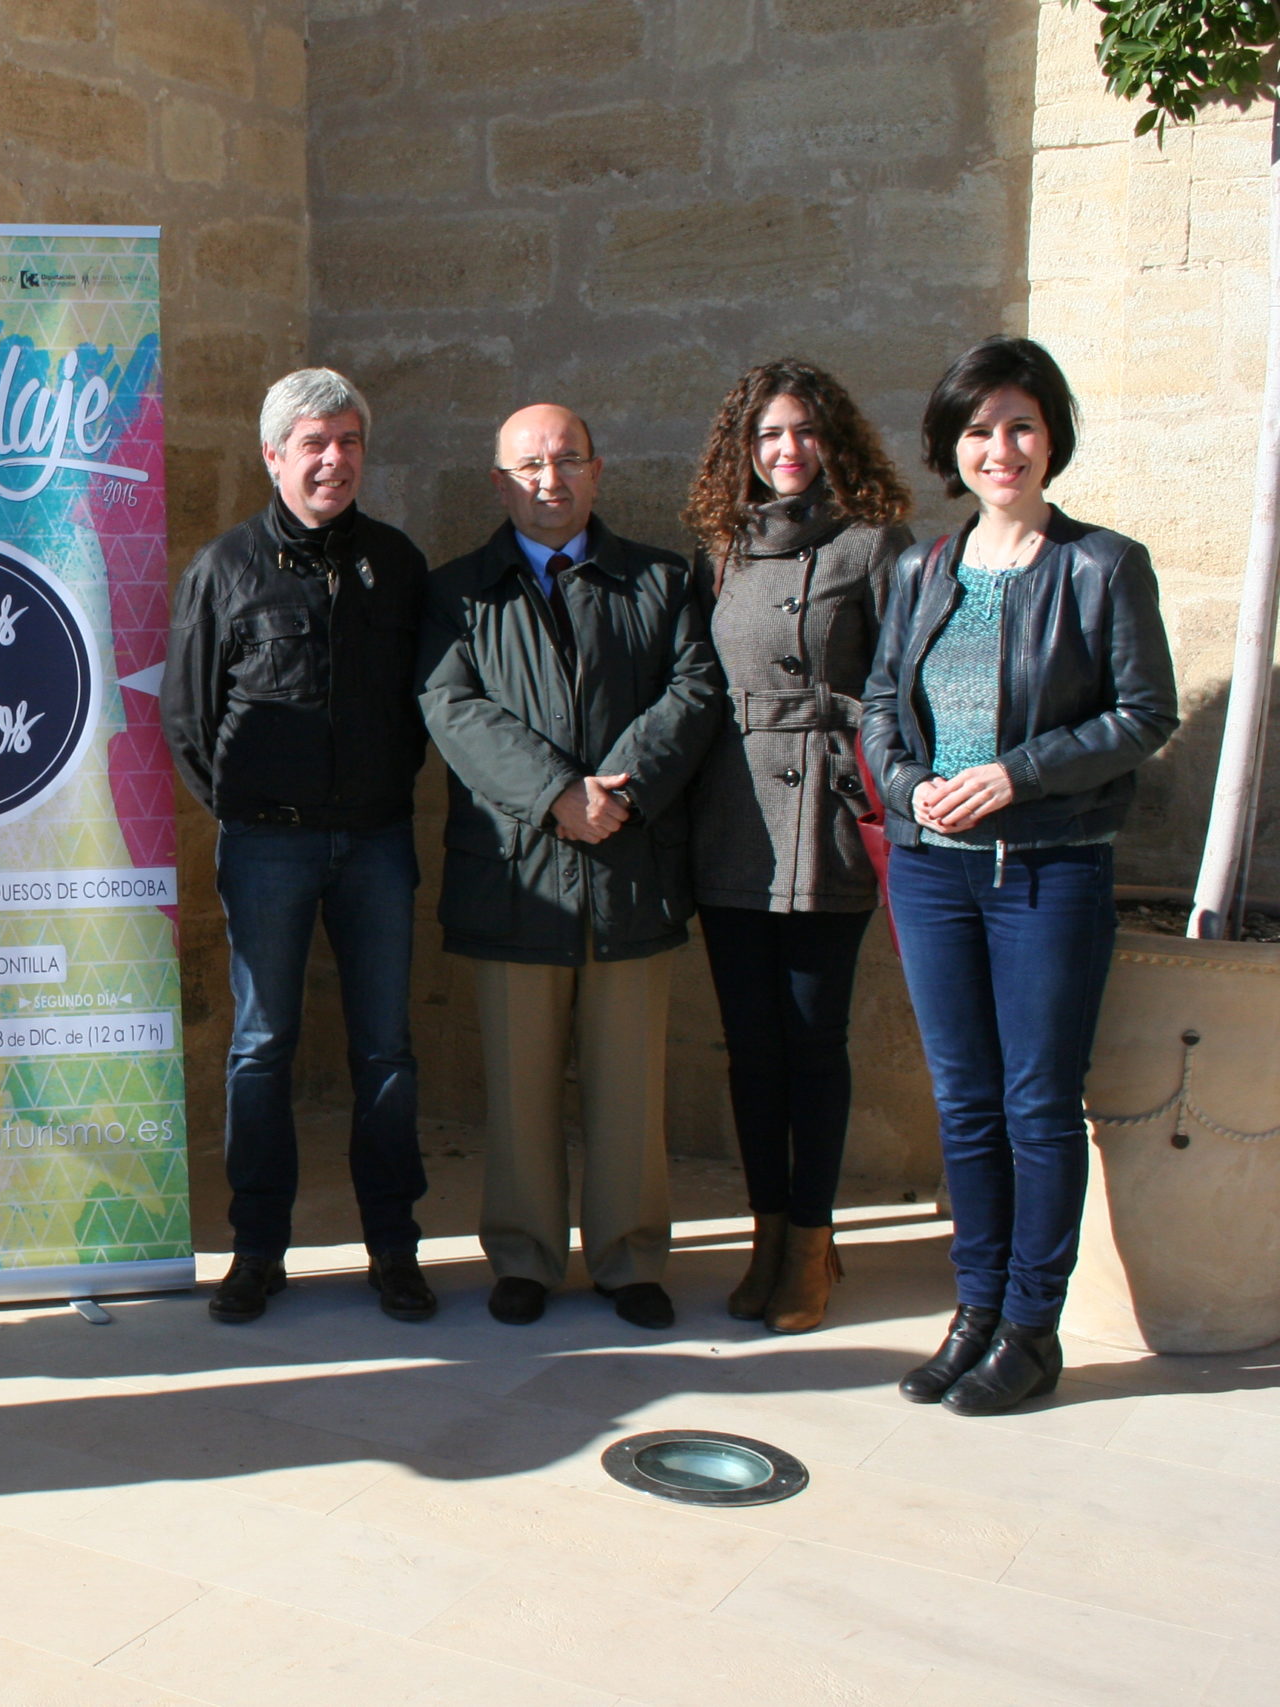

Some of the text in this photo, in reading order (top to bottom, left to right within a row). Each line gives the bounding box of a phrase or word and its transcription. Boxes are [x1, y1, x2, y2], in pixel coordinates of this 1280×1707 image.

[103, 479, 139, 507] 2015
[57, 881, 78, 899] DE
[82, 876, 168, 898] CÓRDOBA
[34, 988, 118, 1009] SEGUNDO DÍA
[7, 1032, 25, 1046] de
[29, 1028, 61, 1045] DIC.
[65, 1029, 83, 1044] de
[88, 1025, 111, 1047] (12
[114, 1030, 125, 1042] a
[130, 1024, 146, 1042] 17
[149, 1023, 164, 1044] h)
